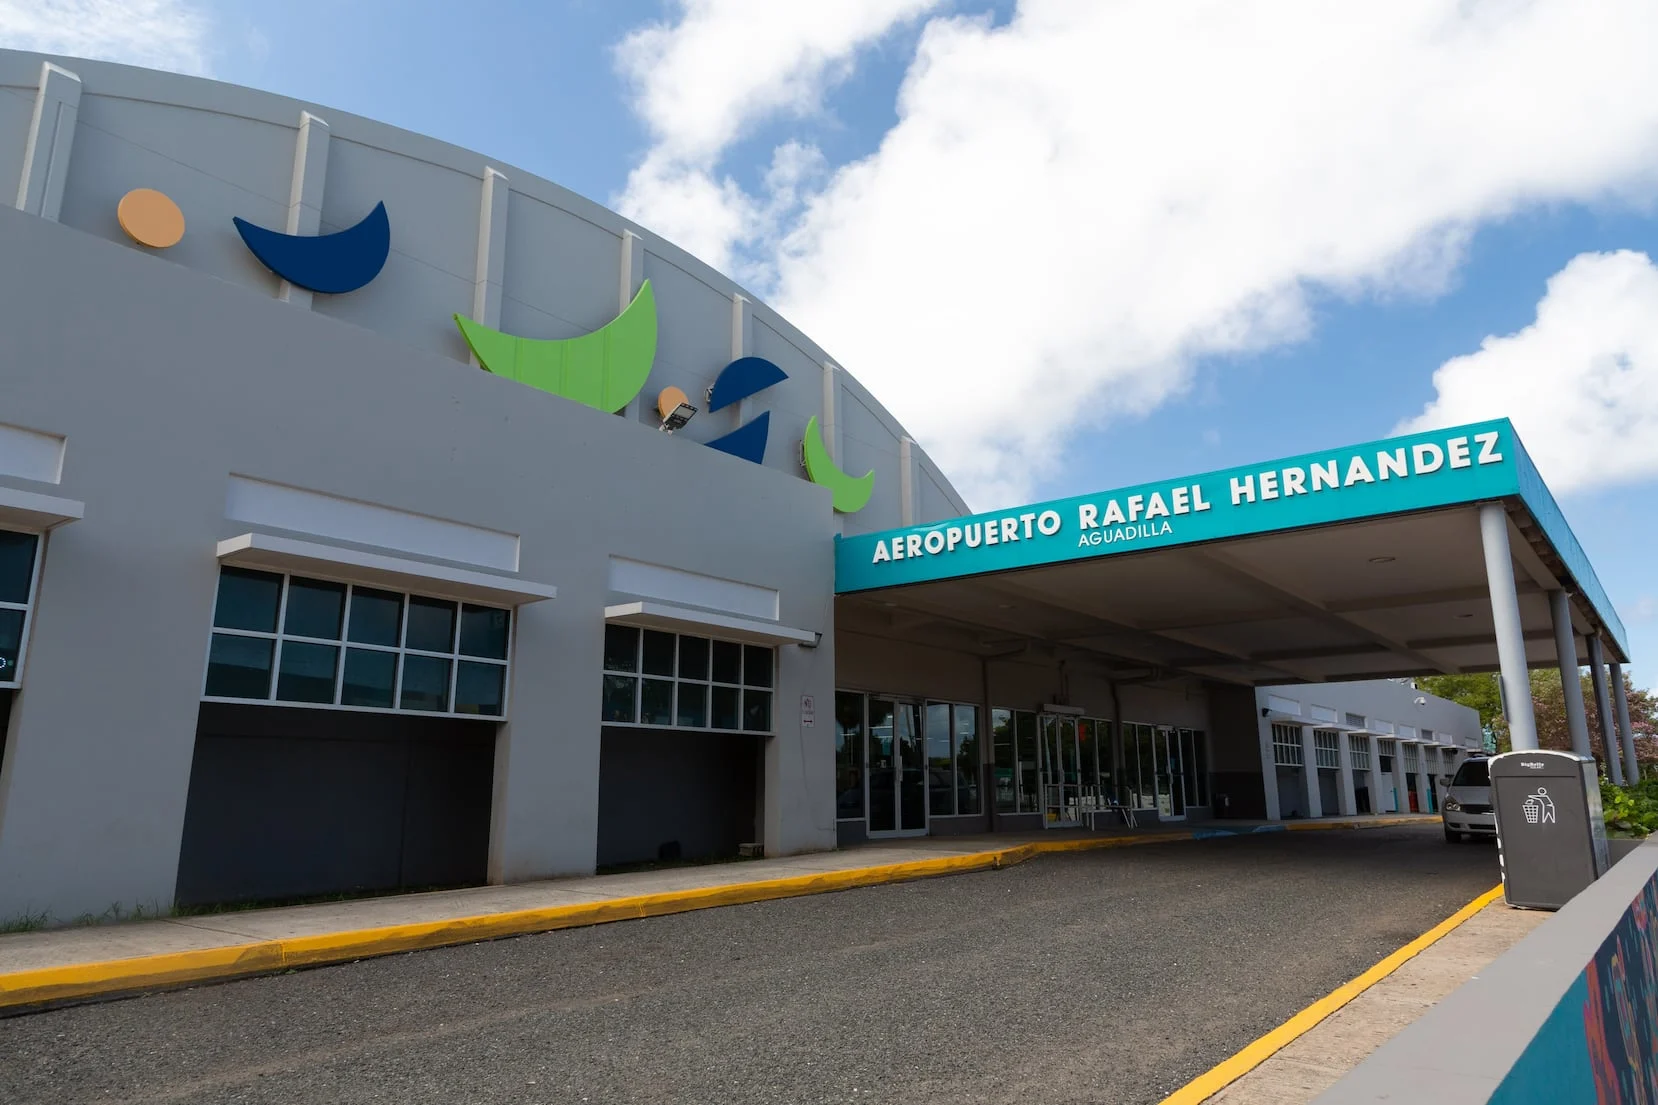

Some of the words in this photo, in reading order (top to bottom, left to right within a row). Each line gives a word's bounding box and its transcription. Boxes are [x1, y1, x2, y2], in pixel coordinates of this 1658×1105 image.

[872, 510, 1061, 563] AEROPUERTO
[1078, 484, 1211, 530] RAFAEL
[1229, 431, 1504, 505] HERNANDEZ
[1078, 521, 1173, 547] AGUADILLA
